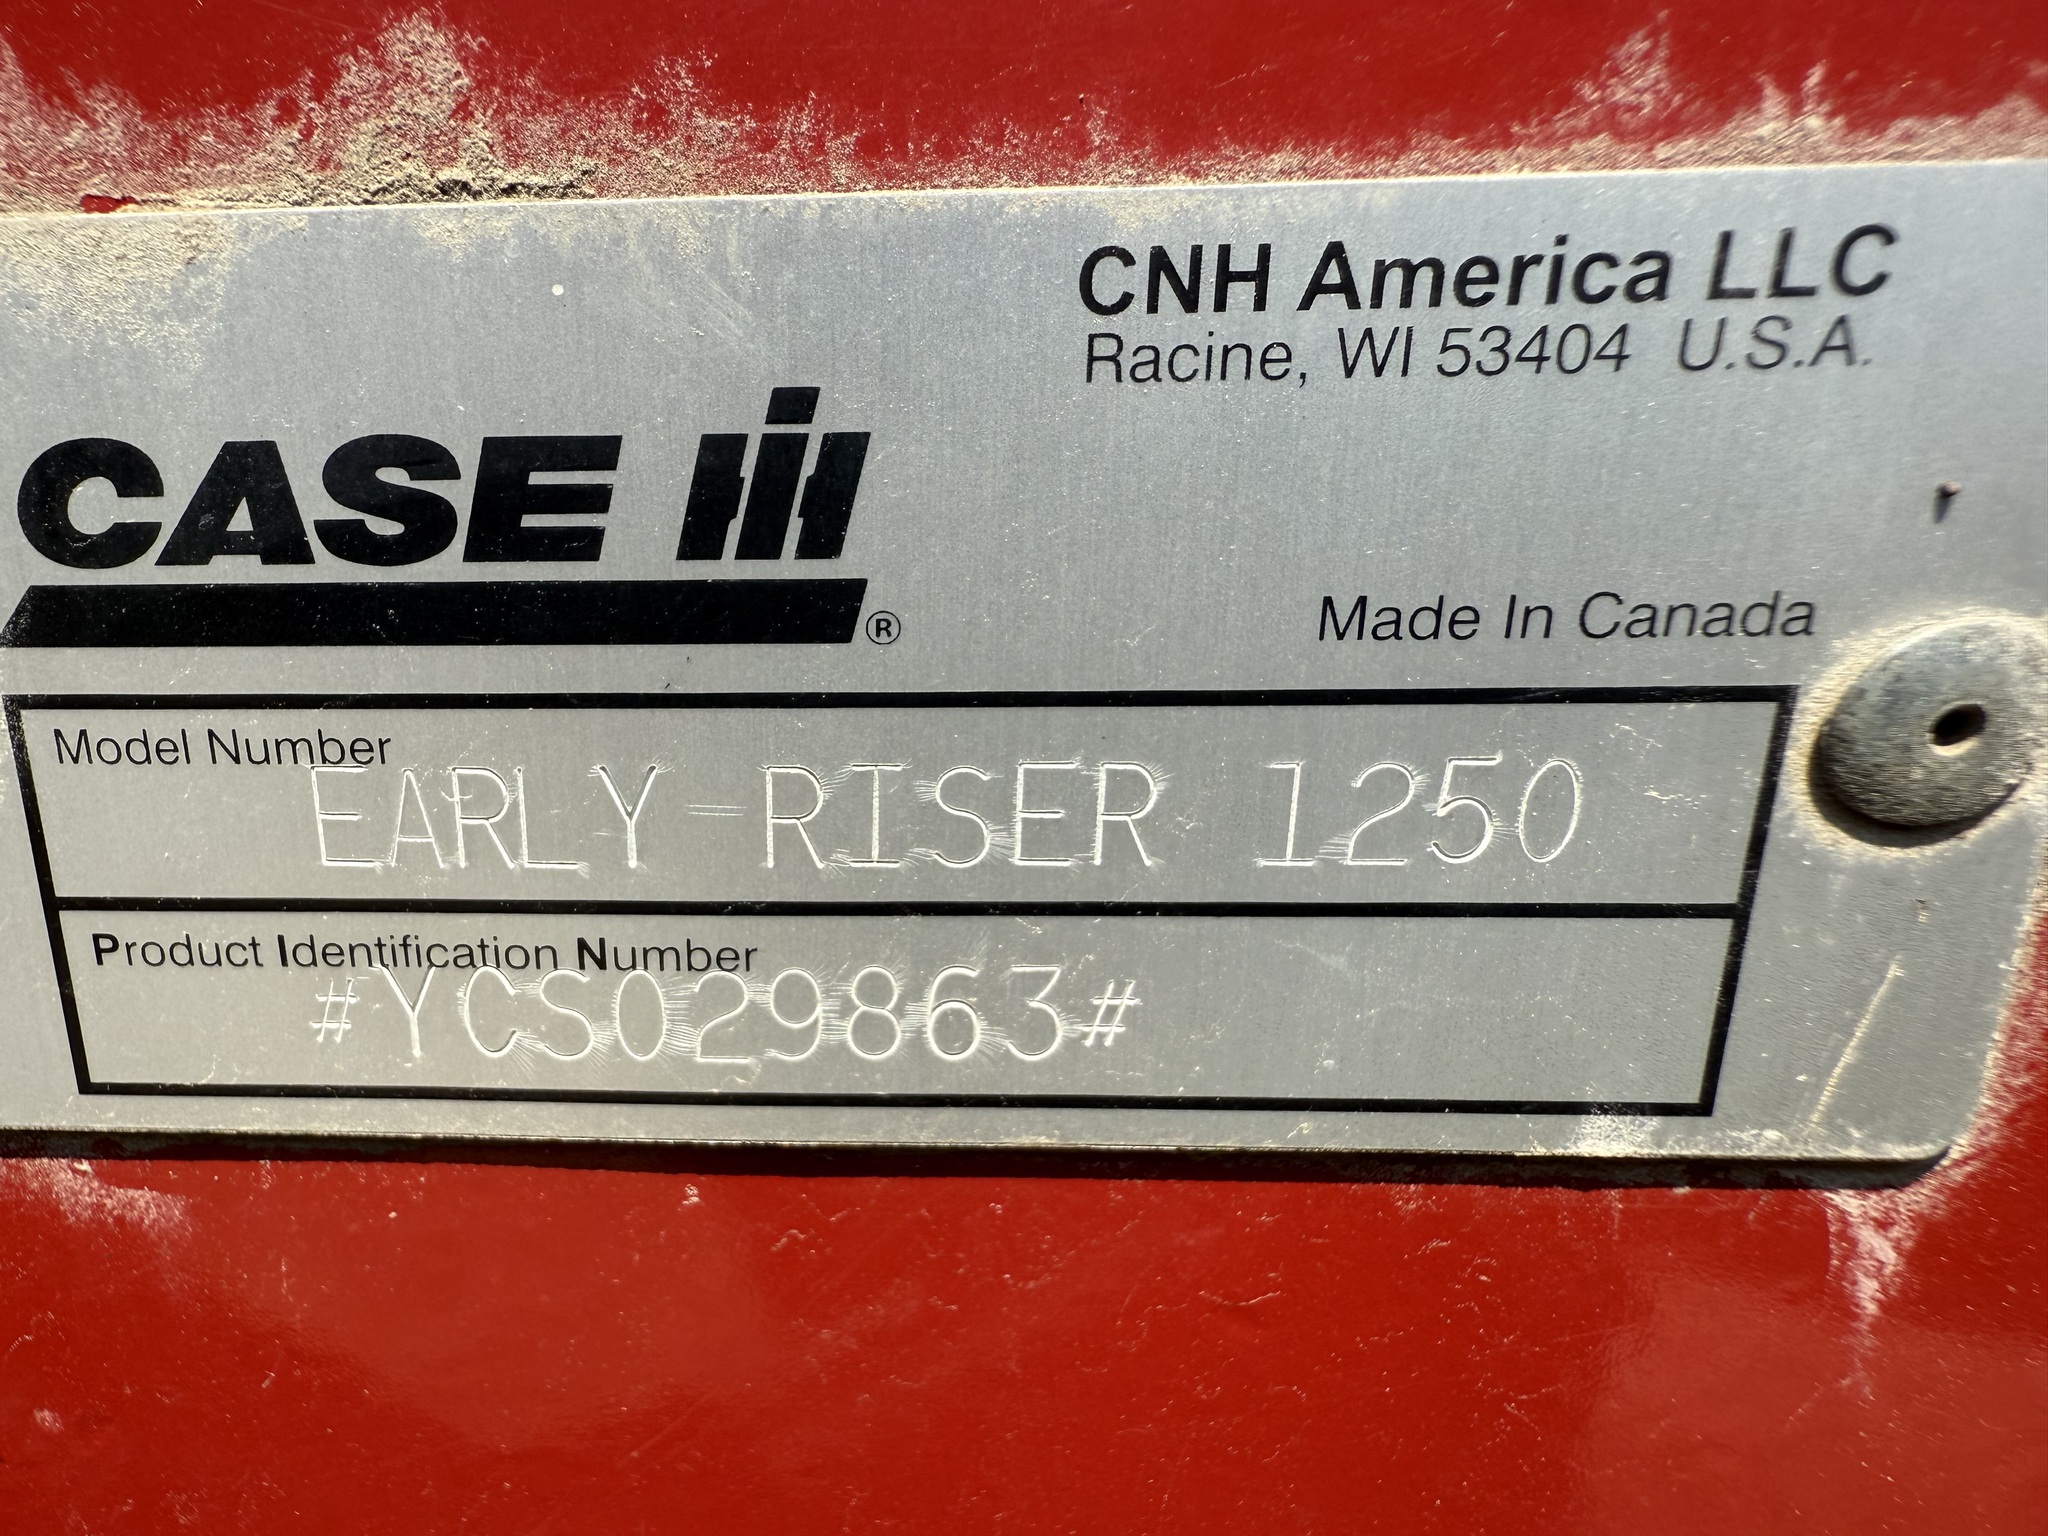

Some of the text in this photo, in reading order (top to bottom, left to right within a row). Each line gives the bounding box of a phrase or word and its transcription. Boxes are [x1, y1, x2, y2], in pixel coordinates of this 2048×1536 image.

[1079, 223, 1899, 315] CNH America LLC
[1086, 314, 1873, 387] Racine, WI 53404 U.S.A.
[17, 434, 622, 569] CASE
[1318, 590, 1815, 641] Made In Canada
[55, 728, 391, 766] Model Number
[1260, 756, 1586, 866] 1250
[93, 933, 758, 973] Product Identification Number
[312, 963, 1143, 1061] #YCS029863#
